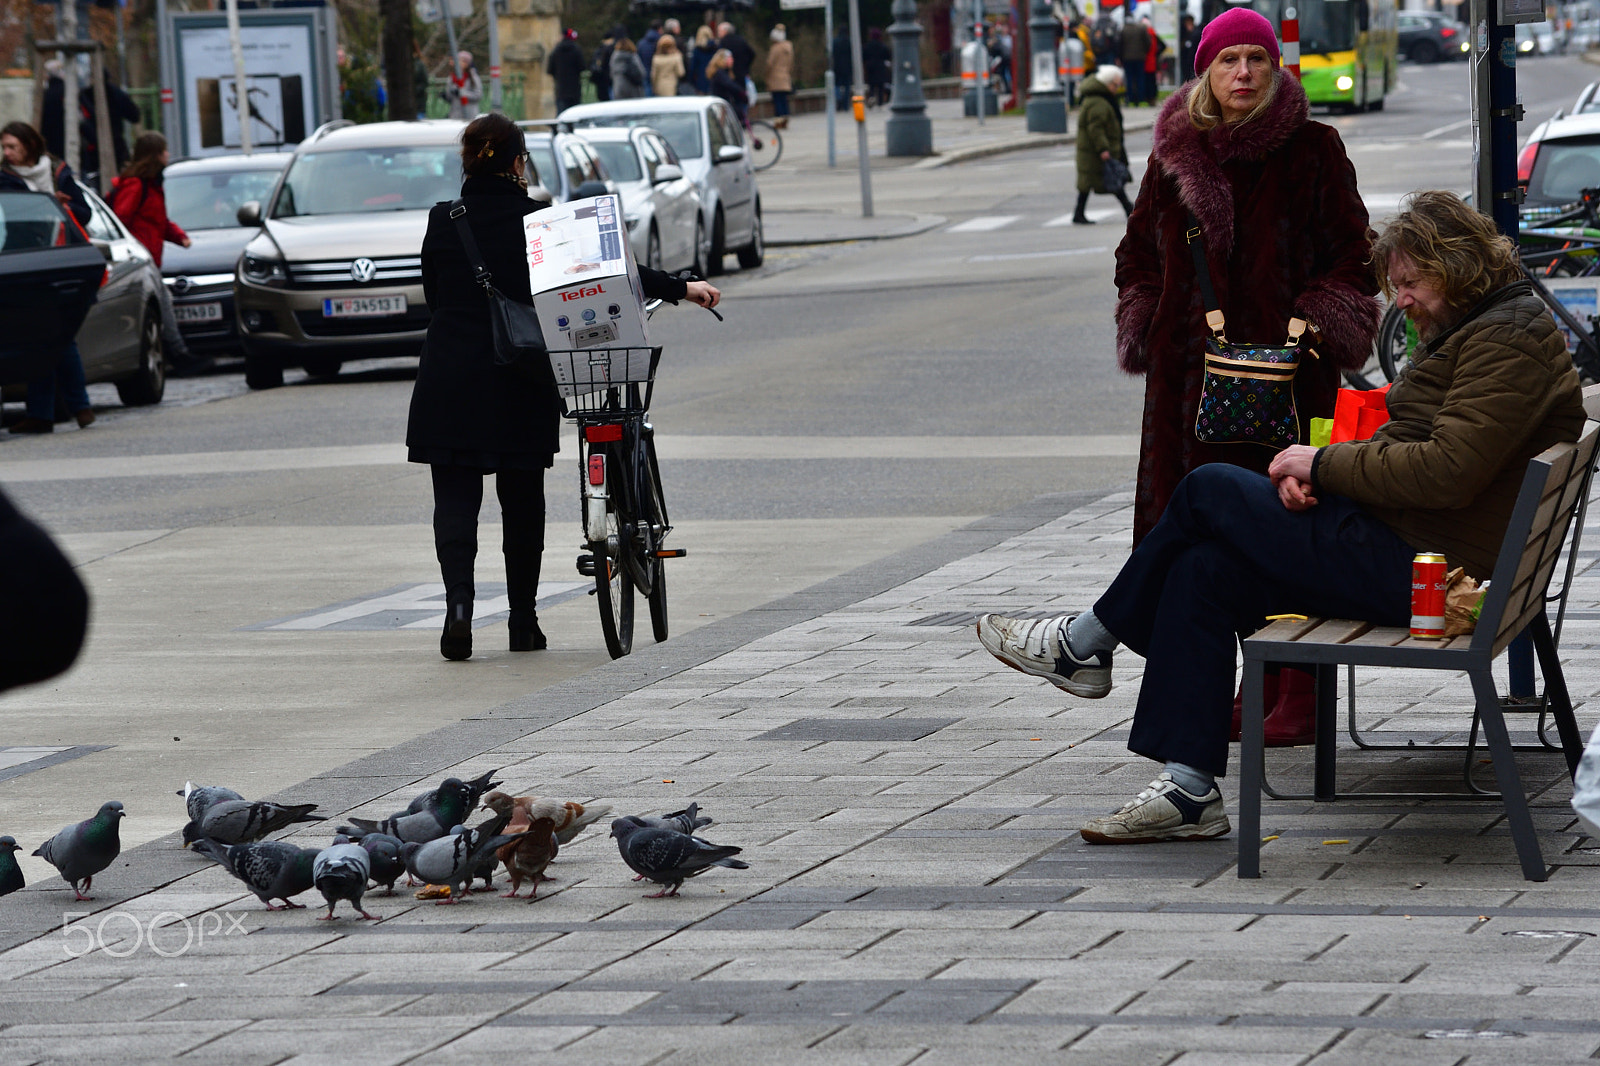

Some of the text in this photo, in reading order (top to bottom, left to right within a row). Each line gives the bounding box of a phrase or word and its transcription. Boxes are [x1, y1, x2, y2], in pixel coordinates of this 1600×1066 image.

[530, 236, 544, 268] Tefal
[558, 284, 606, 302] Tefal
[353, 298, 390, 312] 34513
